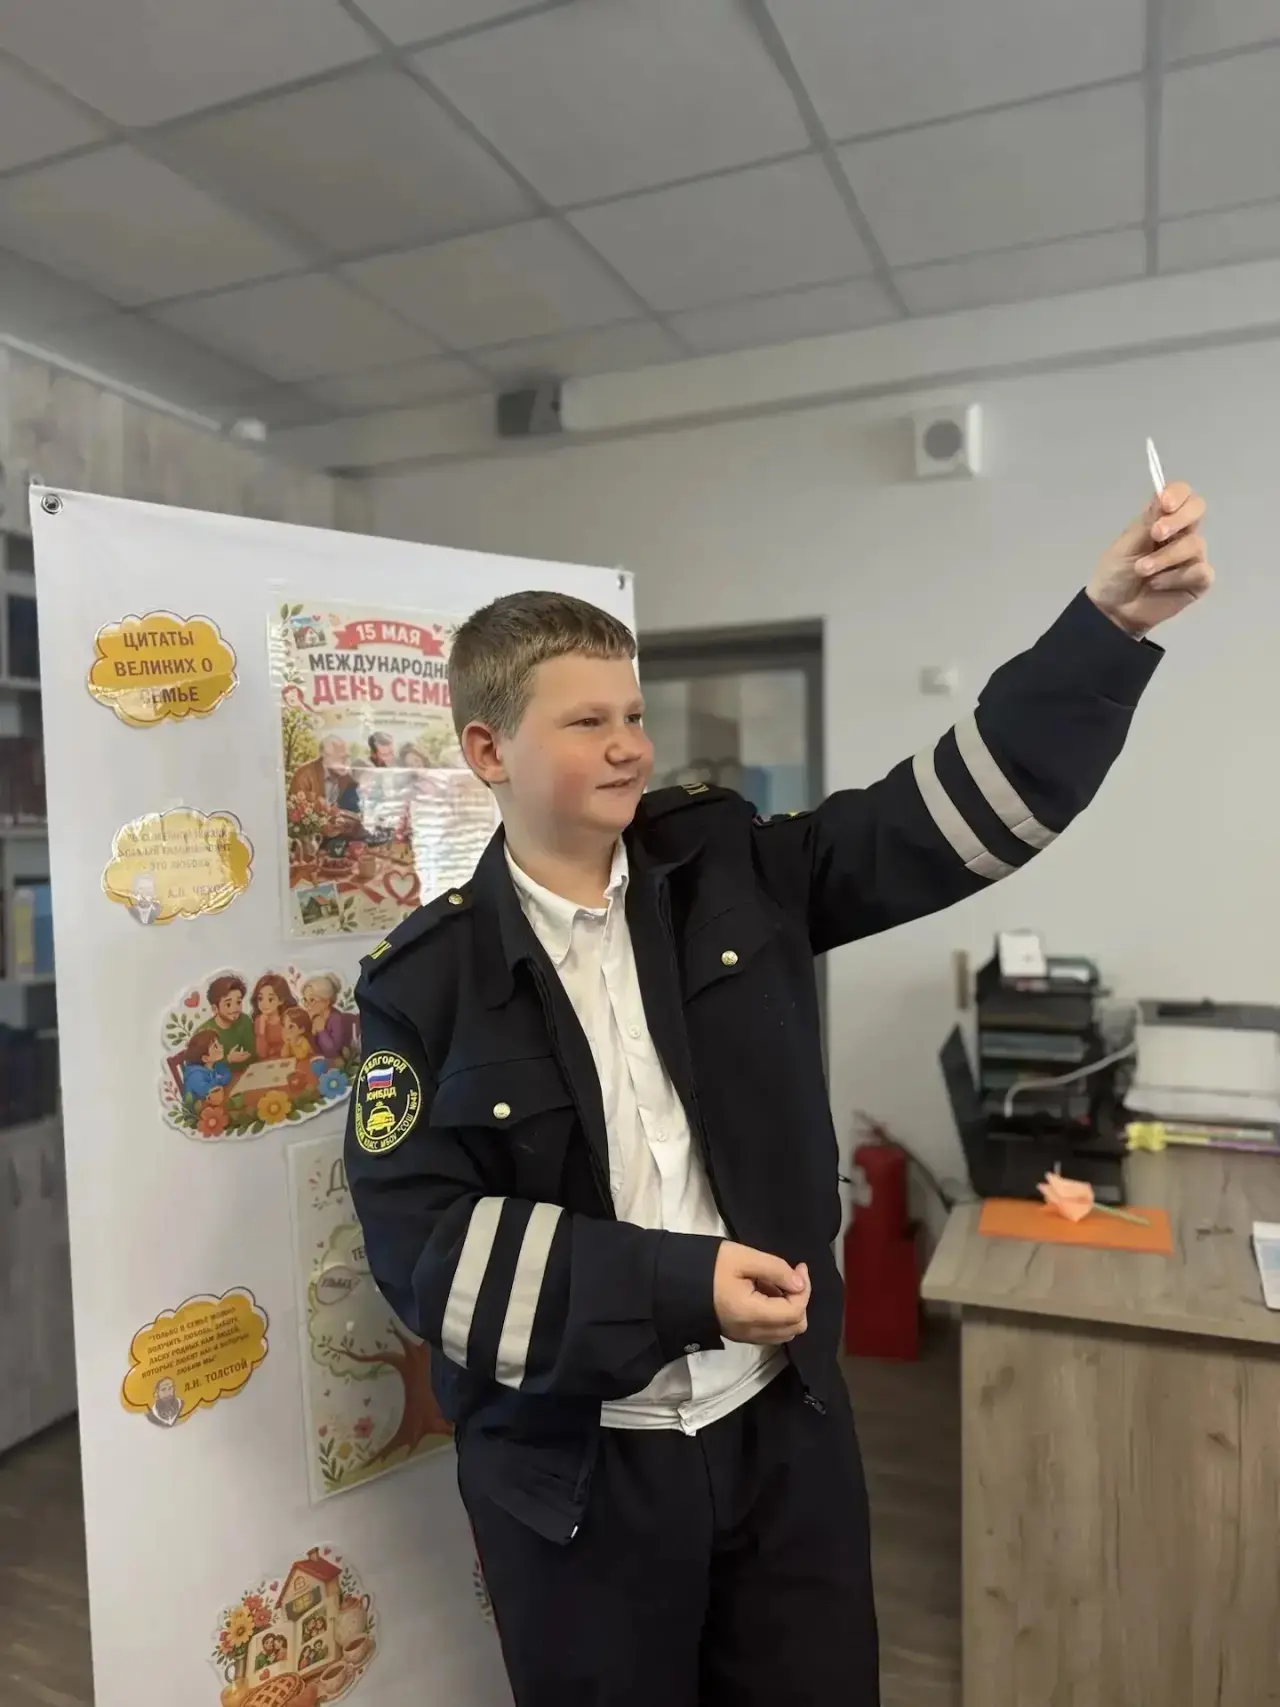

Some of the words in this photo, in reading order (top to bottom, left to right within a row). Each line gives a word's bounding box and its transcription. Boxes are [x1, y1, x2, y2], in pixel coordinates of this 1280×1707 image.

[123, 631, 194, 651] ЦИТАТЫ
[356, 623, 376, 641] 15
[381, 626, 421, 645] МАЯ
[114, 658, 197, 677] ВЕЛИКИХ
[201, 657, 213, 673] О
[312, 675, 384, 705] ДЕНЬ
[364, 1055, 407, 1074] БЕЛГОРОД
[147, 1339, 182, 1354] ПОЛУЧИТЬ
[149, 1352, 170, 1366] ЛАСКУ
[171, 1342, 199, 1356] РОДНЫХ
[201, 1336, 214, 1347] НАМ
[141, 1361, 174, 1379] КОТОРЫЕ
[205, 1358, 248, 1383] ТОЛСТОЙ
